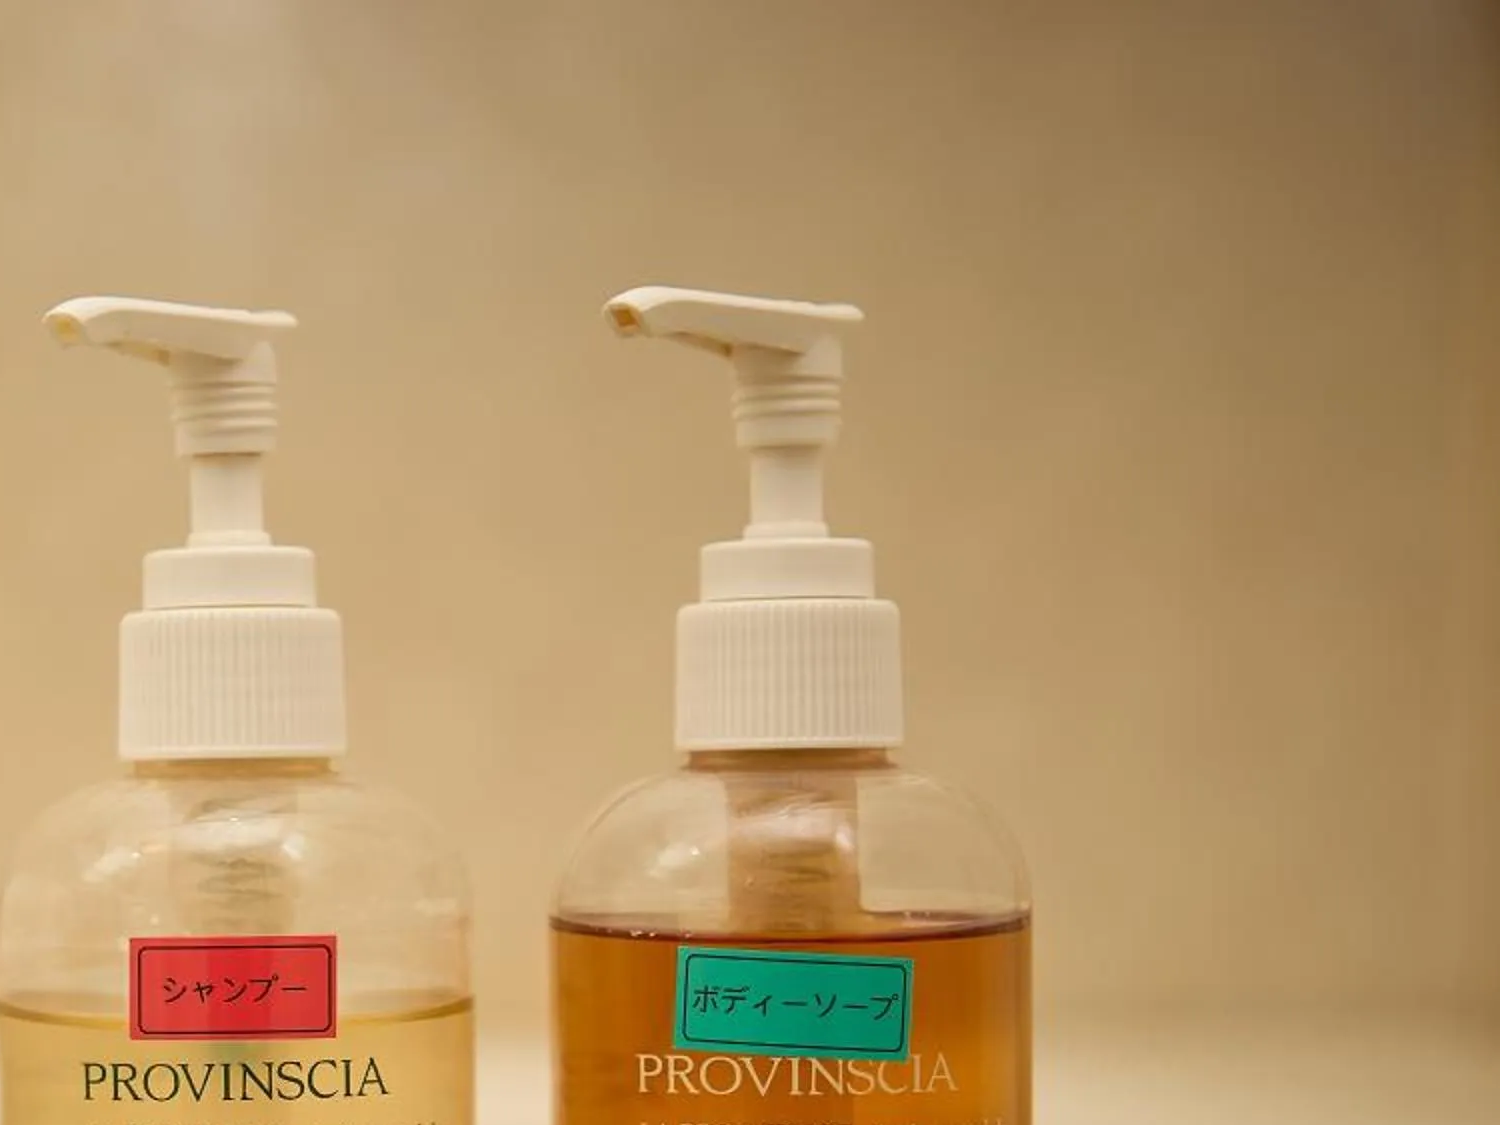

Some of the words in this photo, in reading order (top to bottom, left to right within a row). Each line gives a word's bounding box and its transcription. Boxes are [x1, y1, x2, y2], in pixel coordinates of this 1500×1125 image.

[163, 974, 307, 1004] シャンプー
[692, 986, 901, 1021] ボディーソープ
[82, 1058, 388, 1101] PROVINSCIA
[635, 1053, 958, 1096] PROVINSCIA
